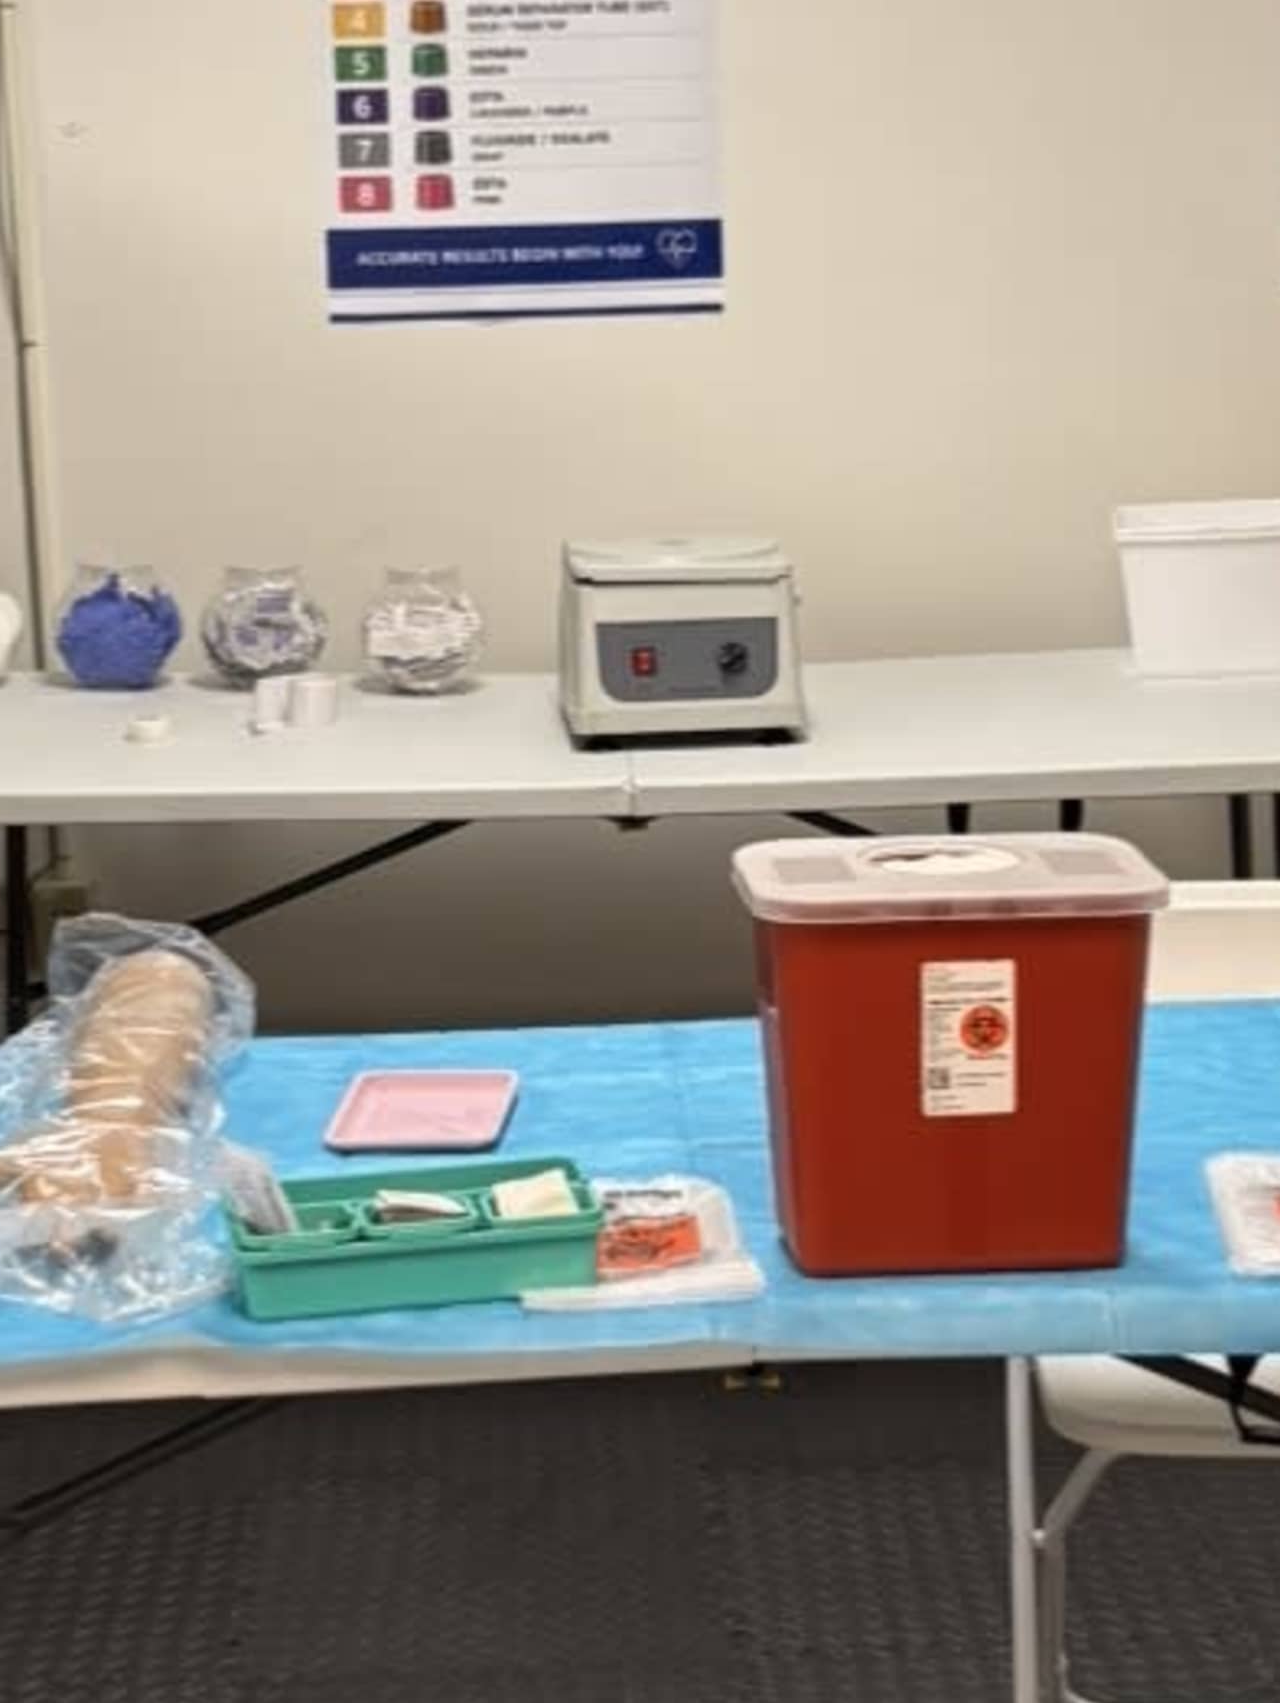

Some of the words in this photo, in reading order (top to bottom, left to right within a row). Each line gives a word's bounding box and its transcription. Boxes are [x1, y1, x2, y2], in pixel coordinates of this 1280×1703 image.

[351, 10, 369, 32] 4
[467, 4, 514, 16] SERUM
[351, 52, 371, 75] 5
[353, 95, 372, 119] 6
[355, 138, 374, 163] 7
[357, 182, 376, 207] 8
[357, 251, 438, 266] ACCURATE
[442, 249, 508, 264] RESULTS
[512, 248, 558, 263] BEGIN
